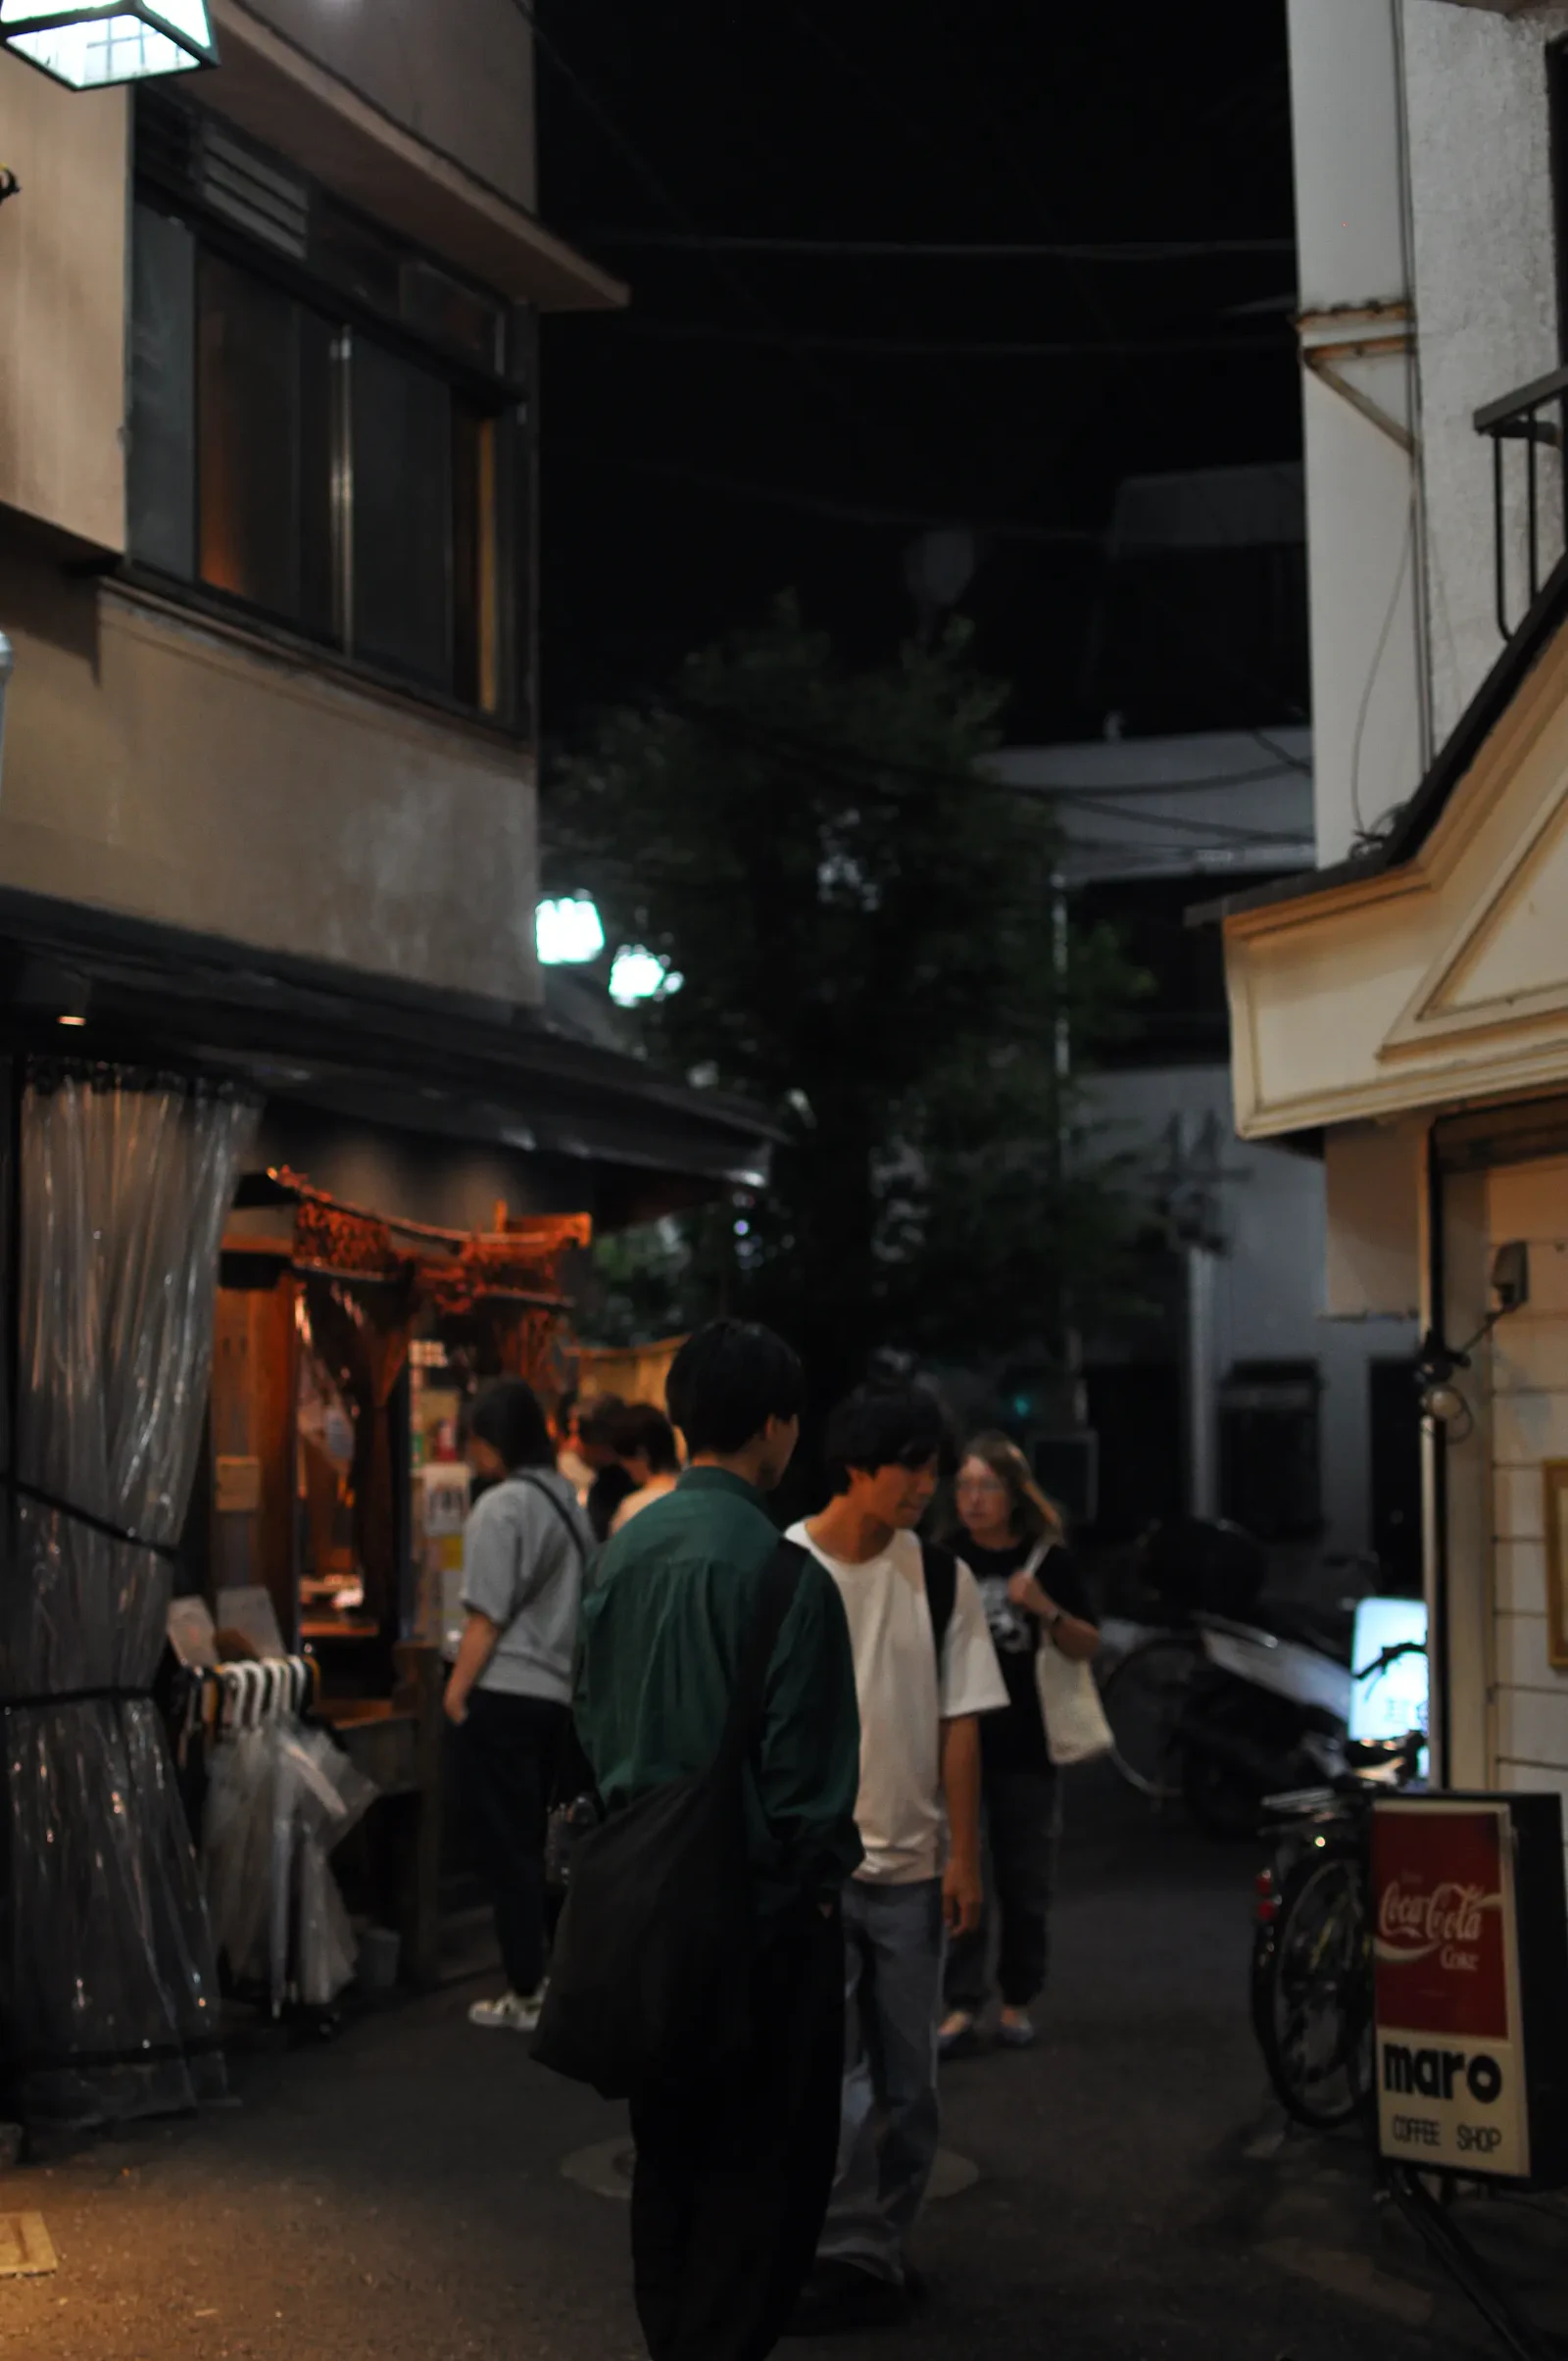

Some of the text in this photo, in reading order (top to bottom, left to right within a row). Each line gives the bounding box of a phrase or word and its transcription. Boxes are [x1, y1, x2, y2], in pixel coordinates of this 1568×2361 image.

[1383, 2042, 1502, 2104] maro
[1393, 2114, 1502, 2153] COFFEE SHOP
